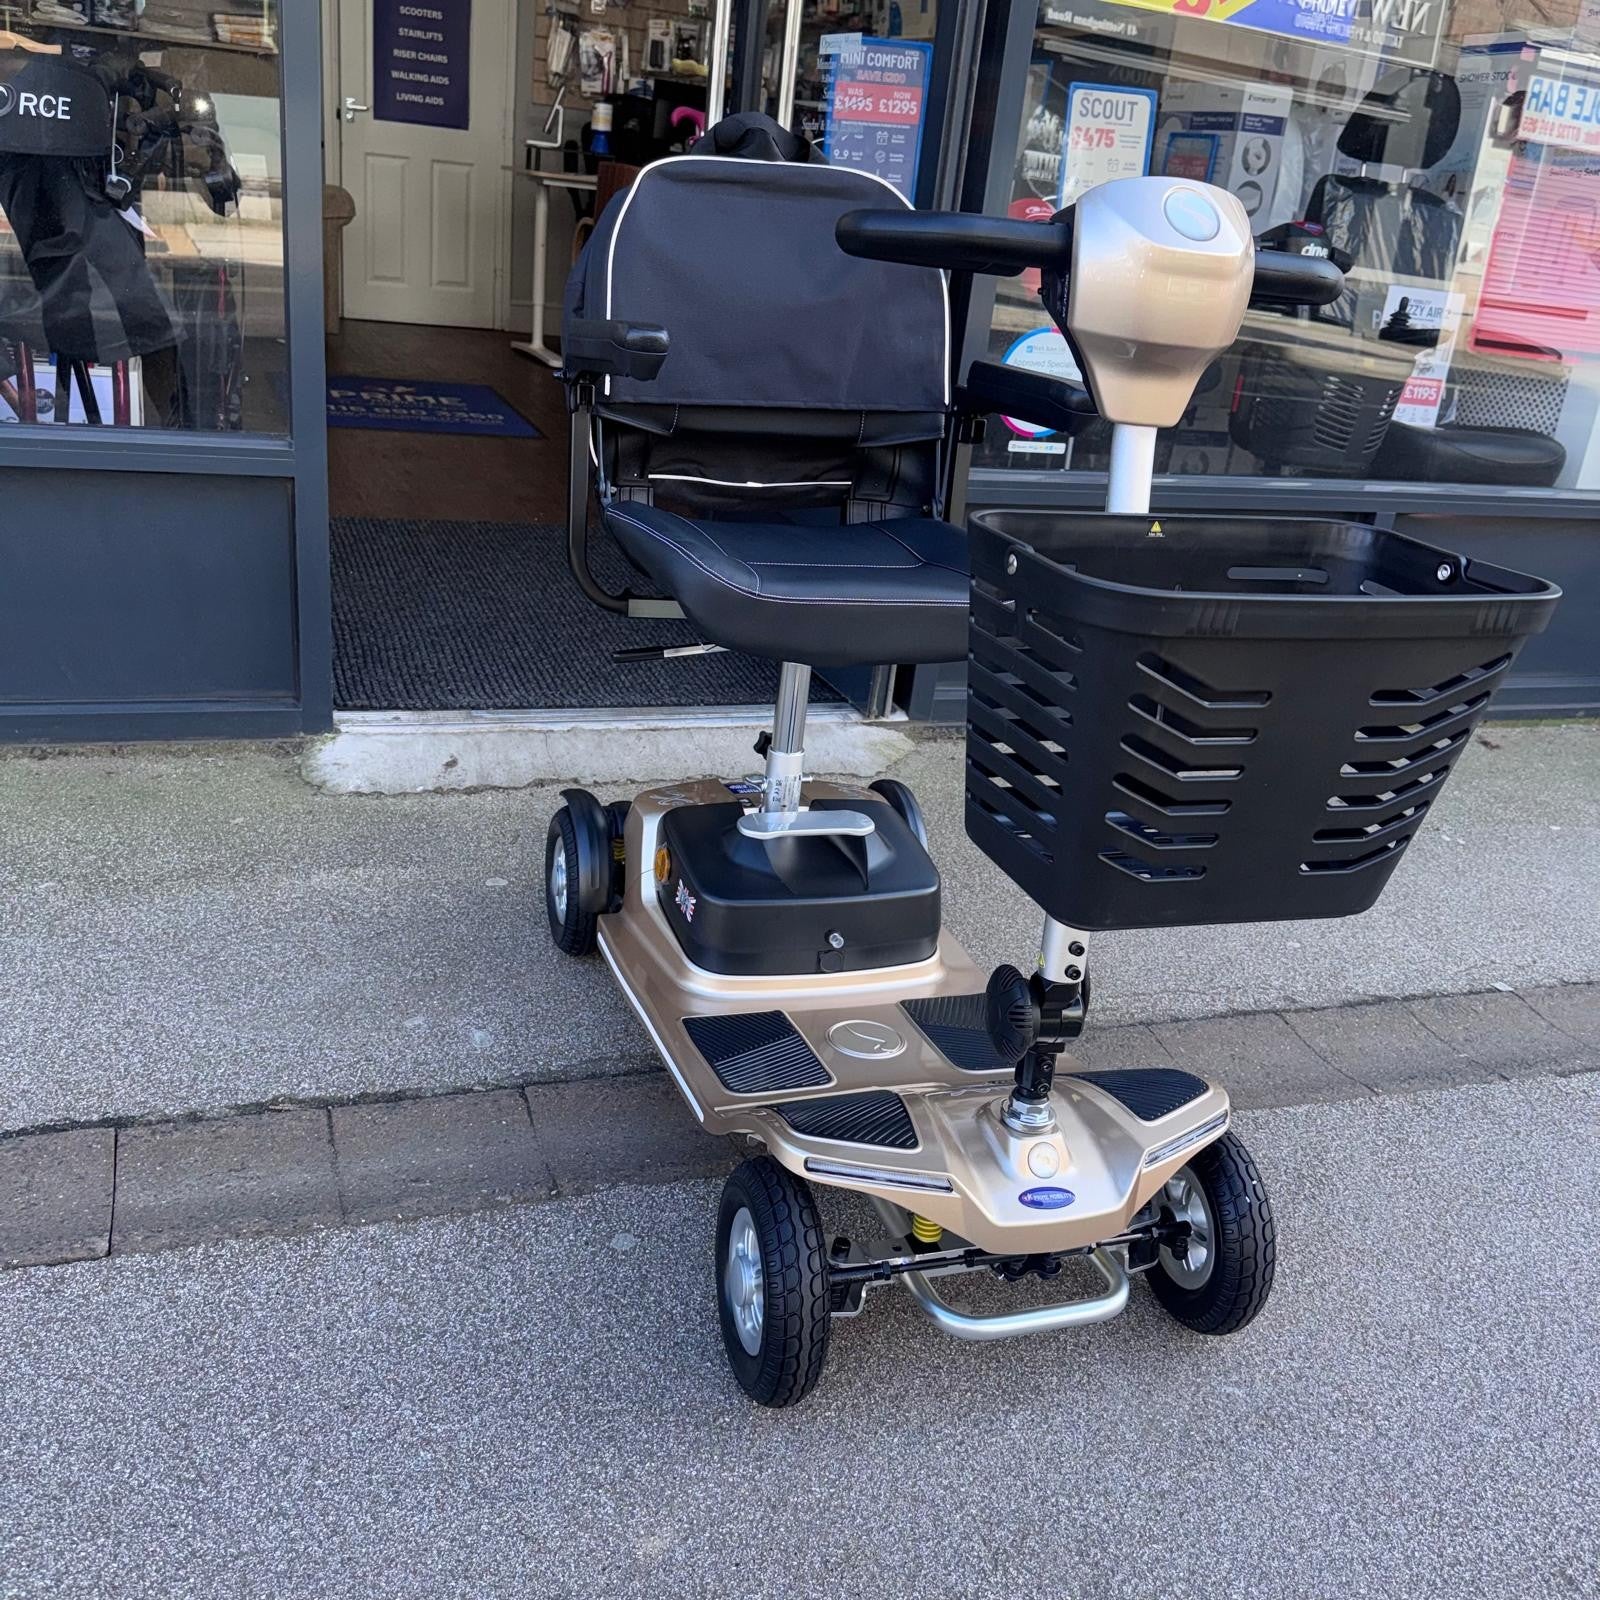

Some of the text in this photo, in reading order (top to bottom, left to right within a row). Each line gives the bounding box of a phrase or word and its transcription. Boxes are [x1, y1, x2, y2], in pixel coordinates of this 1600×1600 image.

[400, 6, 443, 20] SCOOTERS
[398, 27, 443, 41] STAIRLIFTS
[393, 48, 448, 64] RISER CHAIRS
[867, 52, 920, 70] COMFORT
[391, 70, 450, 85] WALKING AIDS
[396, 92, 444, 106] LIVING AIDS
[847, 88, 864, 96] WAS
[894, 91, 911, 99] NOW
[834, 96, 918, 116] £1495 £1295
[1079, 96, 1139, 122] SCOUT
[1072, 126, 1116, 148] £475
[1426, 307, 1444, 320] AIR
[1403, 384, 1438, 401] £1195
